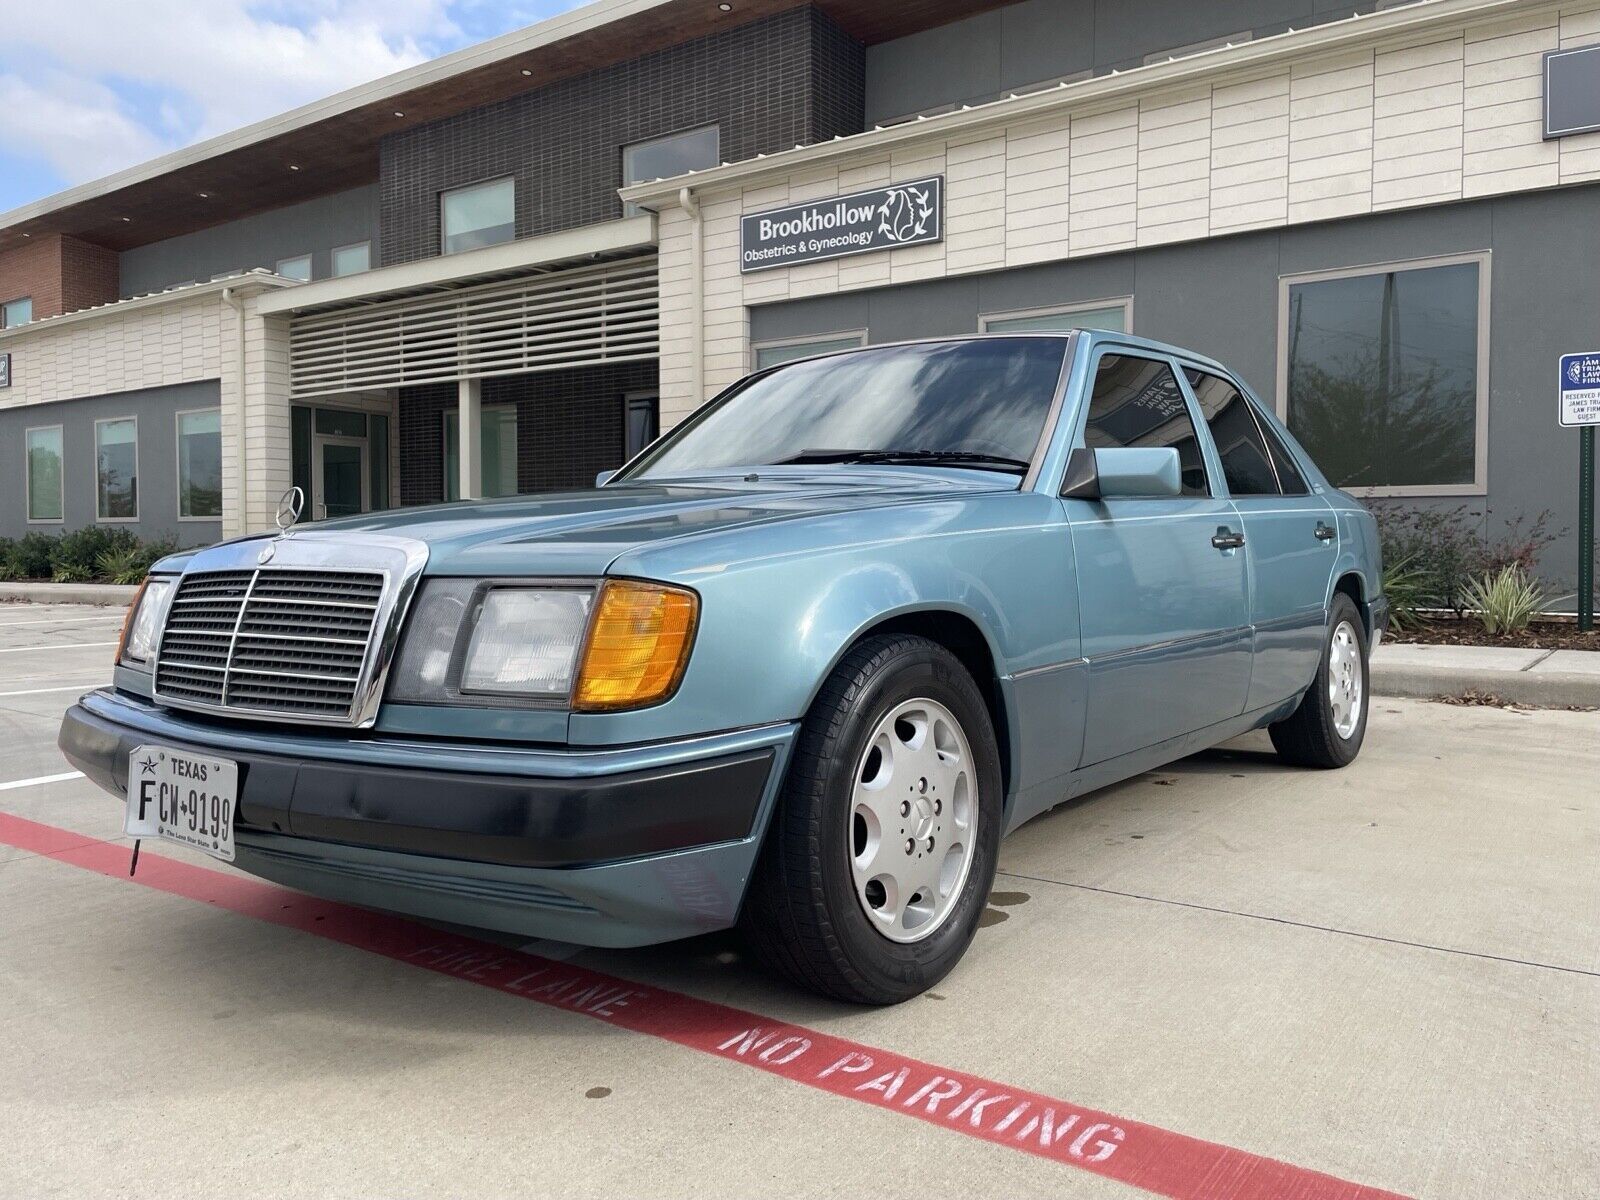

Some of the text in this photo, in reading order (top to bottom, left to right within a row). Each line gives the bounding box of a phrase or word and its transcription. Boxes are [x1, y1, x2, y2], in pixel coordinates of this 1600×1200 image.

[759, 202, 876, 241] Brookhollow
[744, 230, 873, 262] Obstetrics & Gynecology
[171, 757, 208, 782] TEXAS
[166, 829, 210, 848] The Lone Star State
[505, 968, 647, 1018] LANE
[716, 1027, 812, 1066] NO
[816, 1051, 1126, 1163] PARKING
